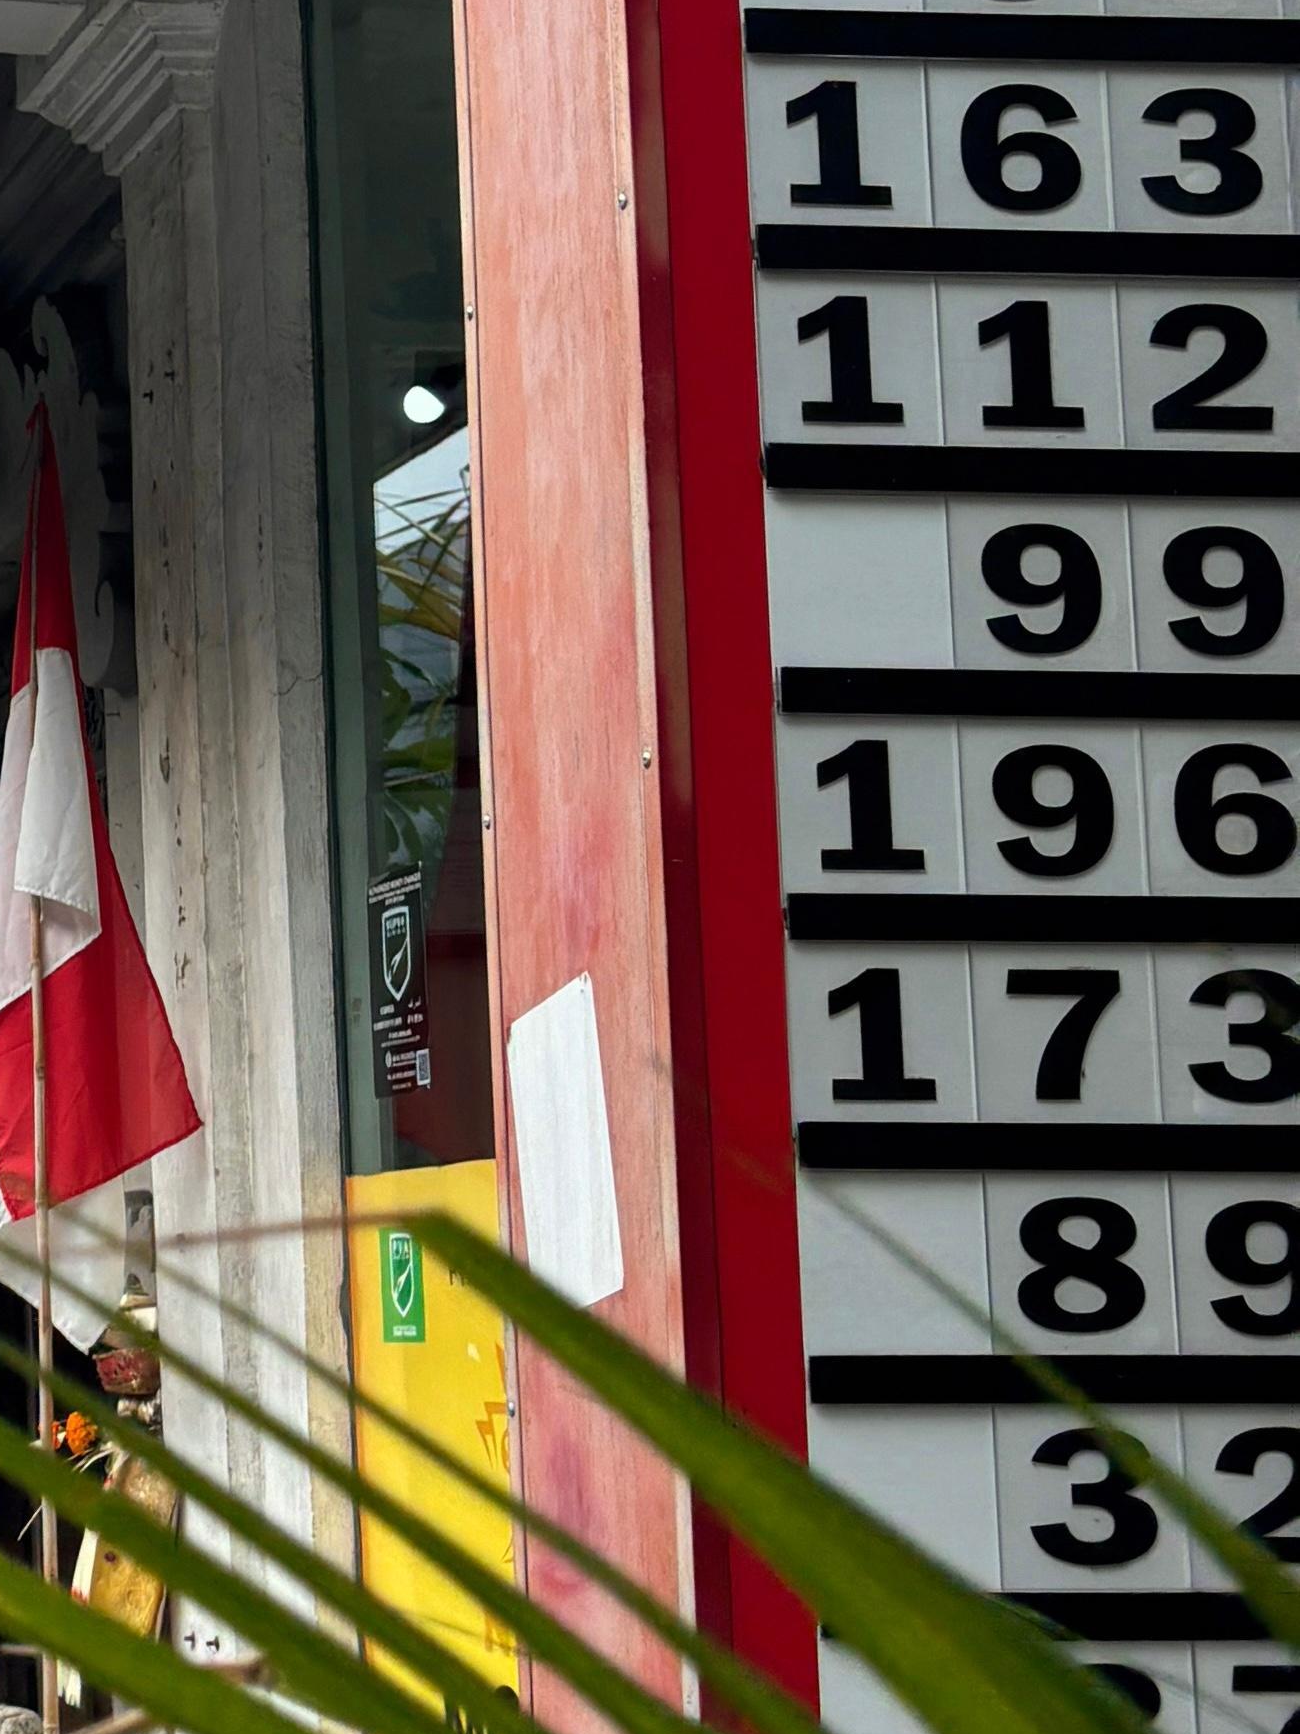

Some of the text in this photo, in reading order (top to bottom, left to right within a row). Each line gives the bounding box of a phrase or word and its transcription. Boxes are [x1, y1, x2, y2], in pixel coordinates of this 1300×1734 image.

[786, 80, 1264, 215] 163
[797, 296, 1274, 431] 112
[981, 523, 1285, 656] 99
[816, 740, 1298, 877] 196
[828, 967, 1300, 1103] 173
[1017, 1196, 1300, 1336] 89
